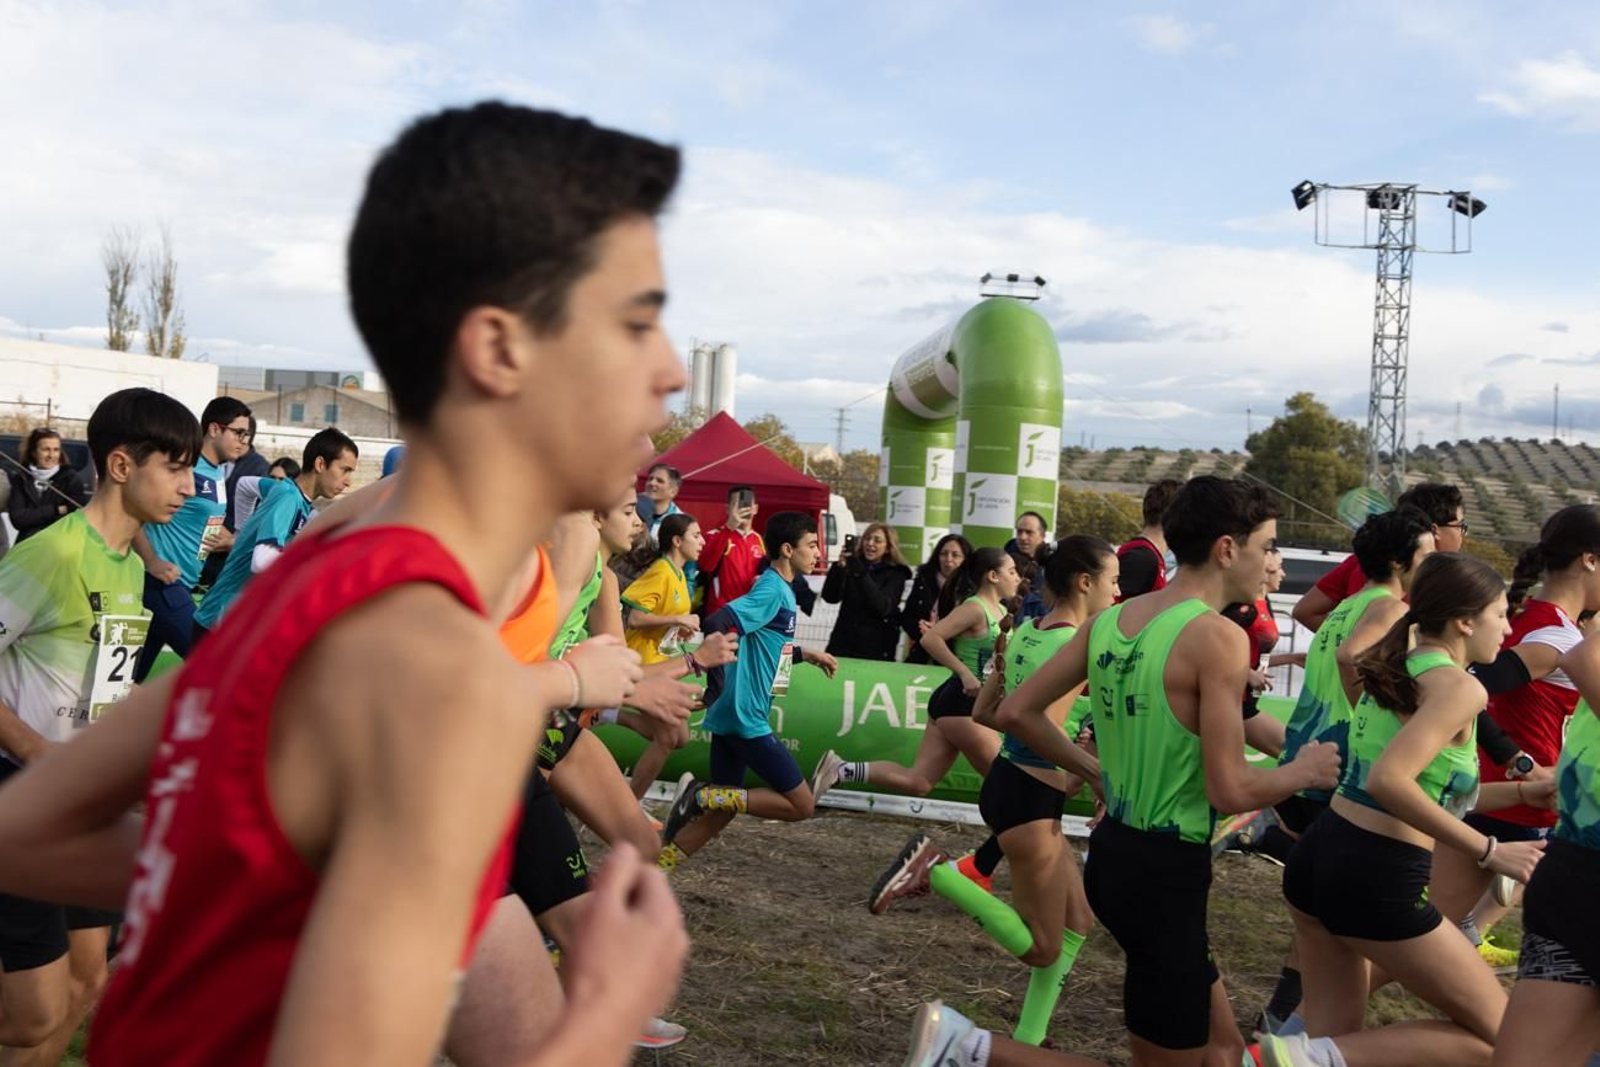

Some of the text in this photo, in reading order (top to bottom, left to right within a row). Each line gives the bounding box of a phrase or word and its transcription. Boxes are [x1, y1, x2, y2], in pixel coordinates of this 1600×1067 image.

[107, 646, 142, 683] 21
[57, 705, 90, 720] CER
[837, 675, 933, 738] JAÉ
